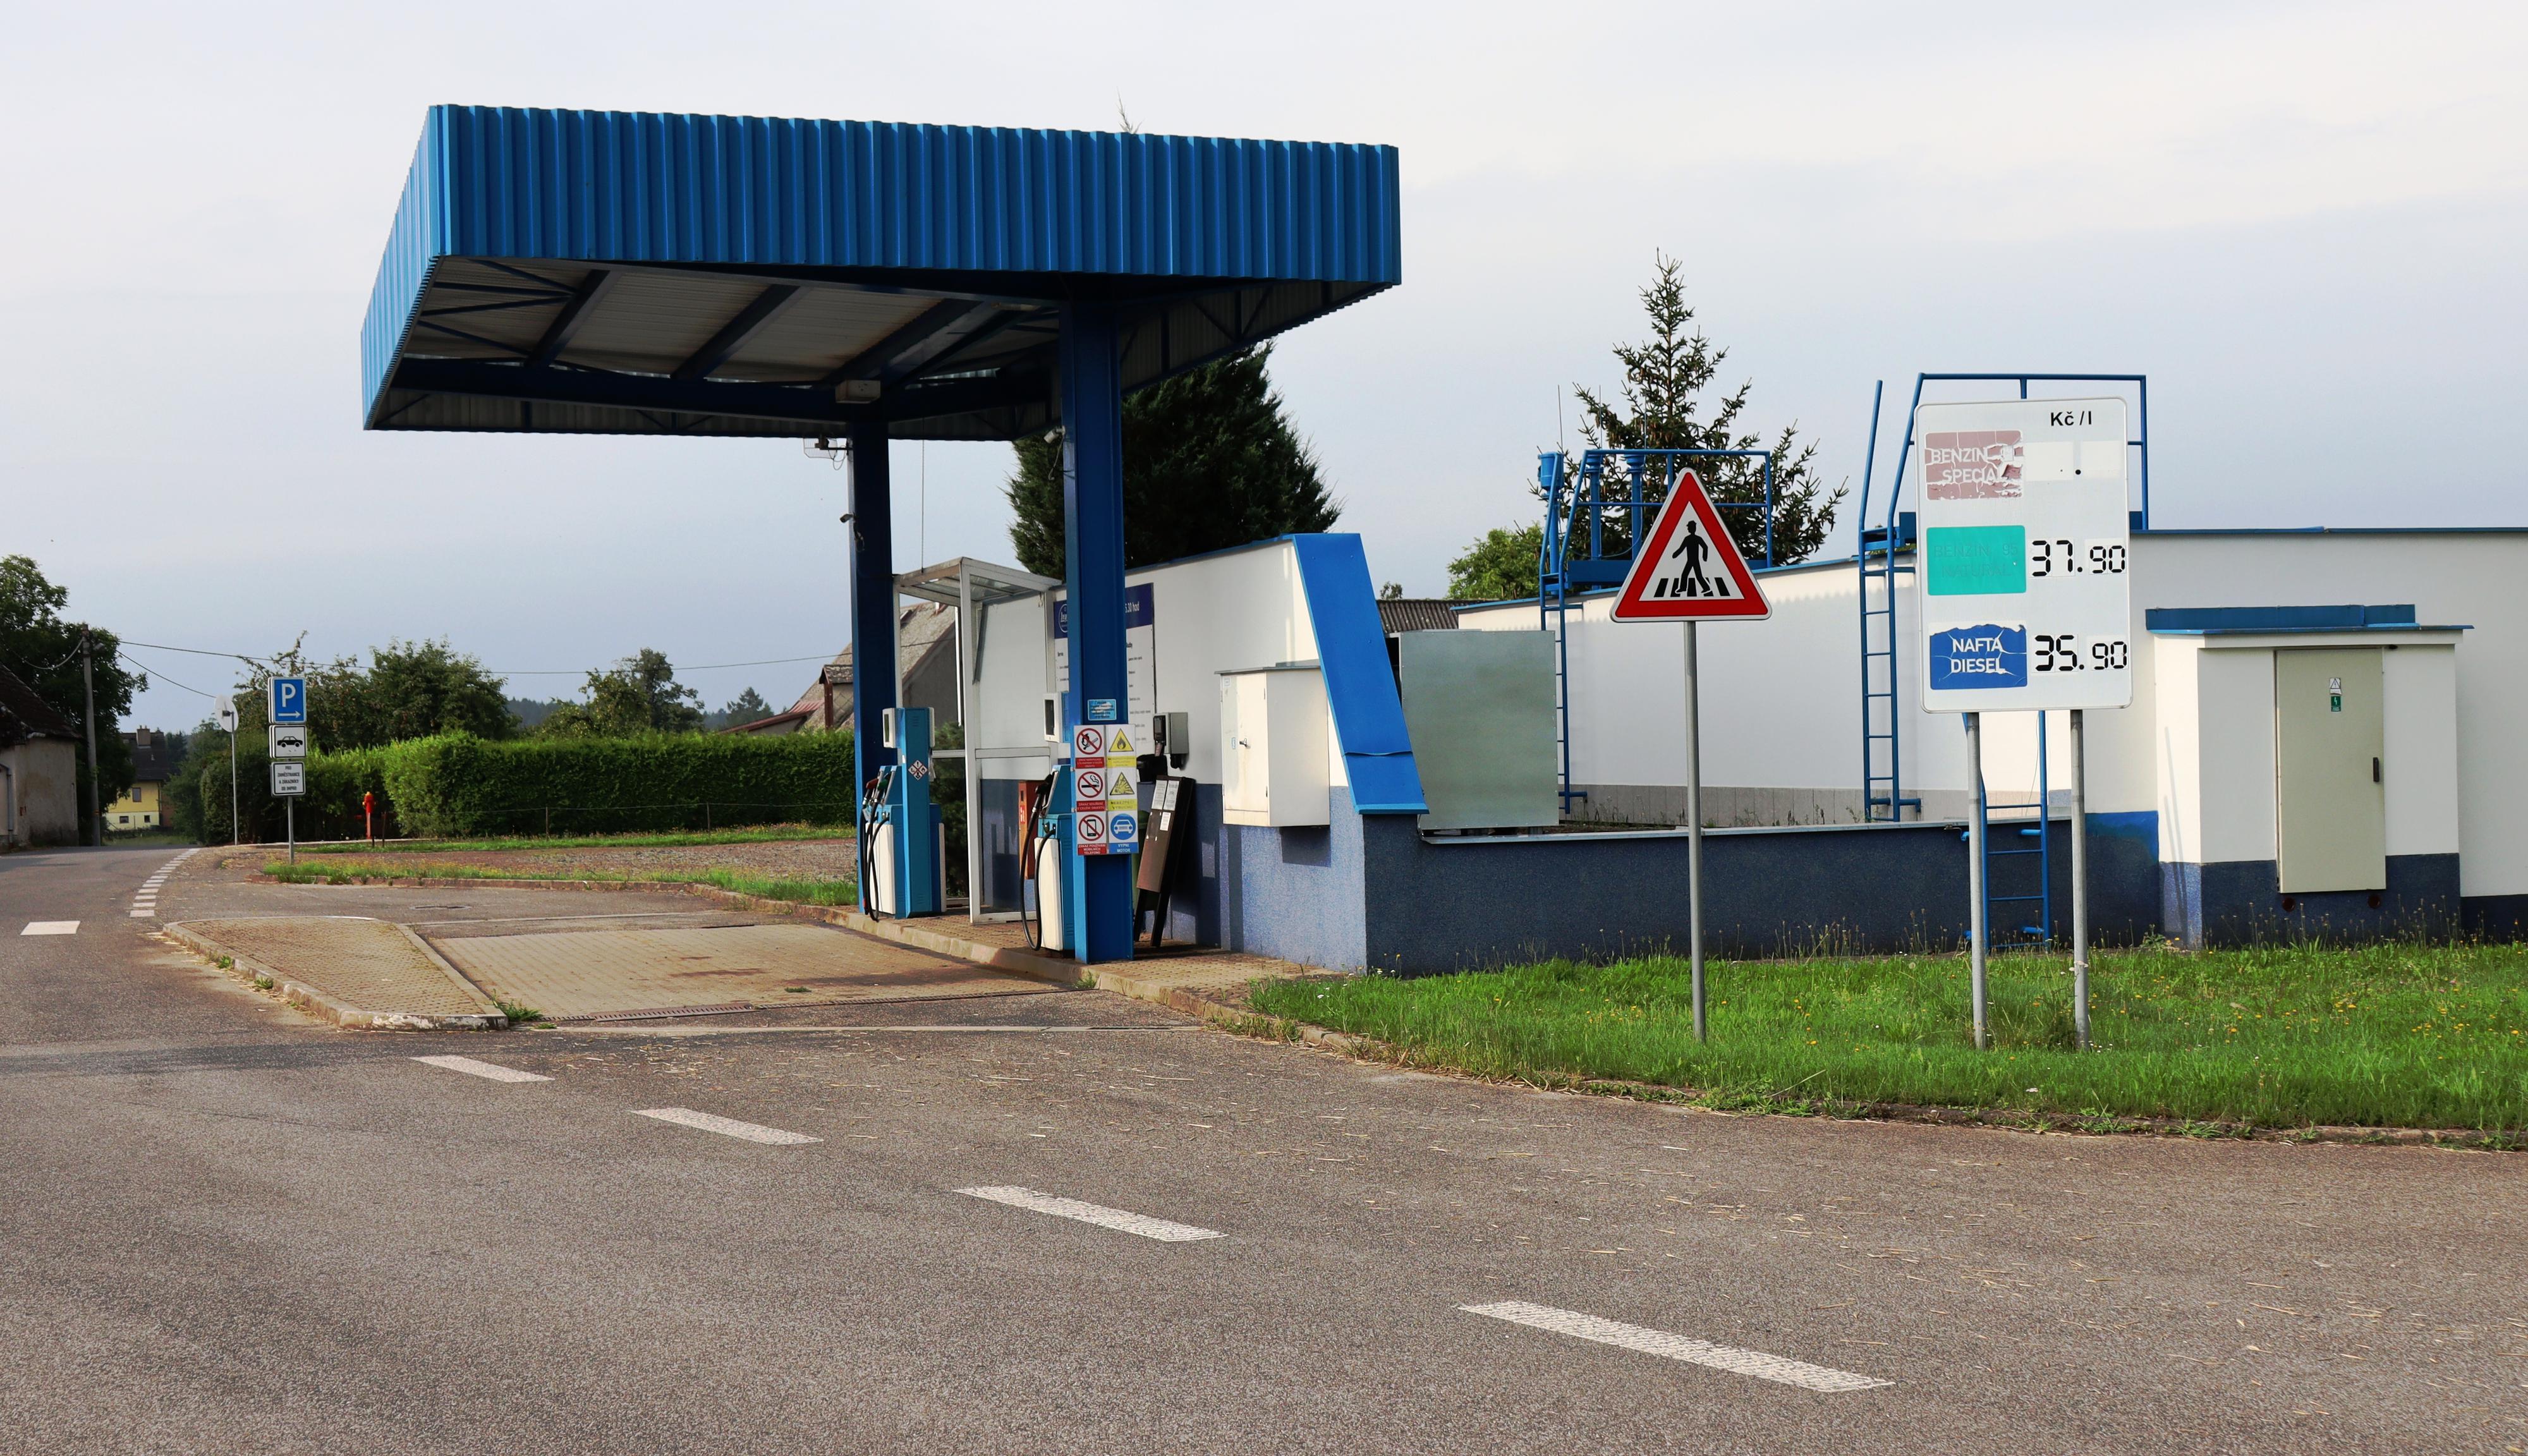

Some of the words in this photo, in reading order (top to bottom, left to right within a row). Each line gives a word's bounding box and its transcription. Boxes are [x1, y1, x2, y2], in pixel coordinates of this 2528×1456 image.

[1931, 447, 1988, 464] BENZIN
[1934, 544, 1990, 558] BENZIN
[2002, 543, 2018, 556] 95
[1952, 637, 2003, 653] NAFTA
[1950, 658, 2006, 674] DIESEL
[281, 683, 296, 707] P
